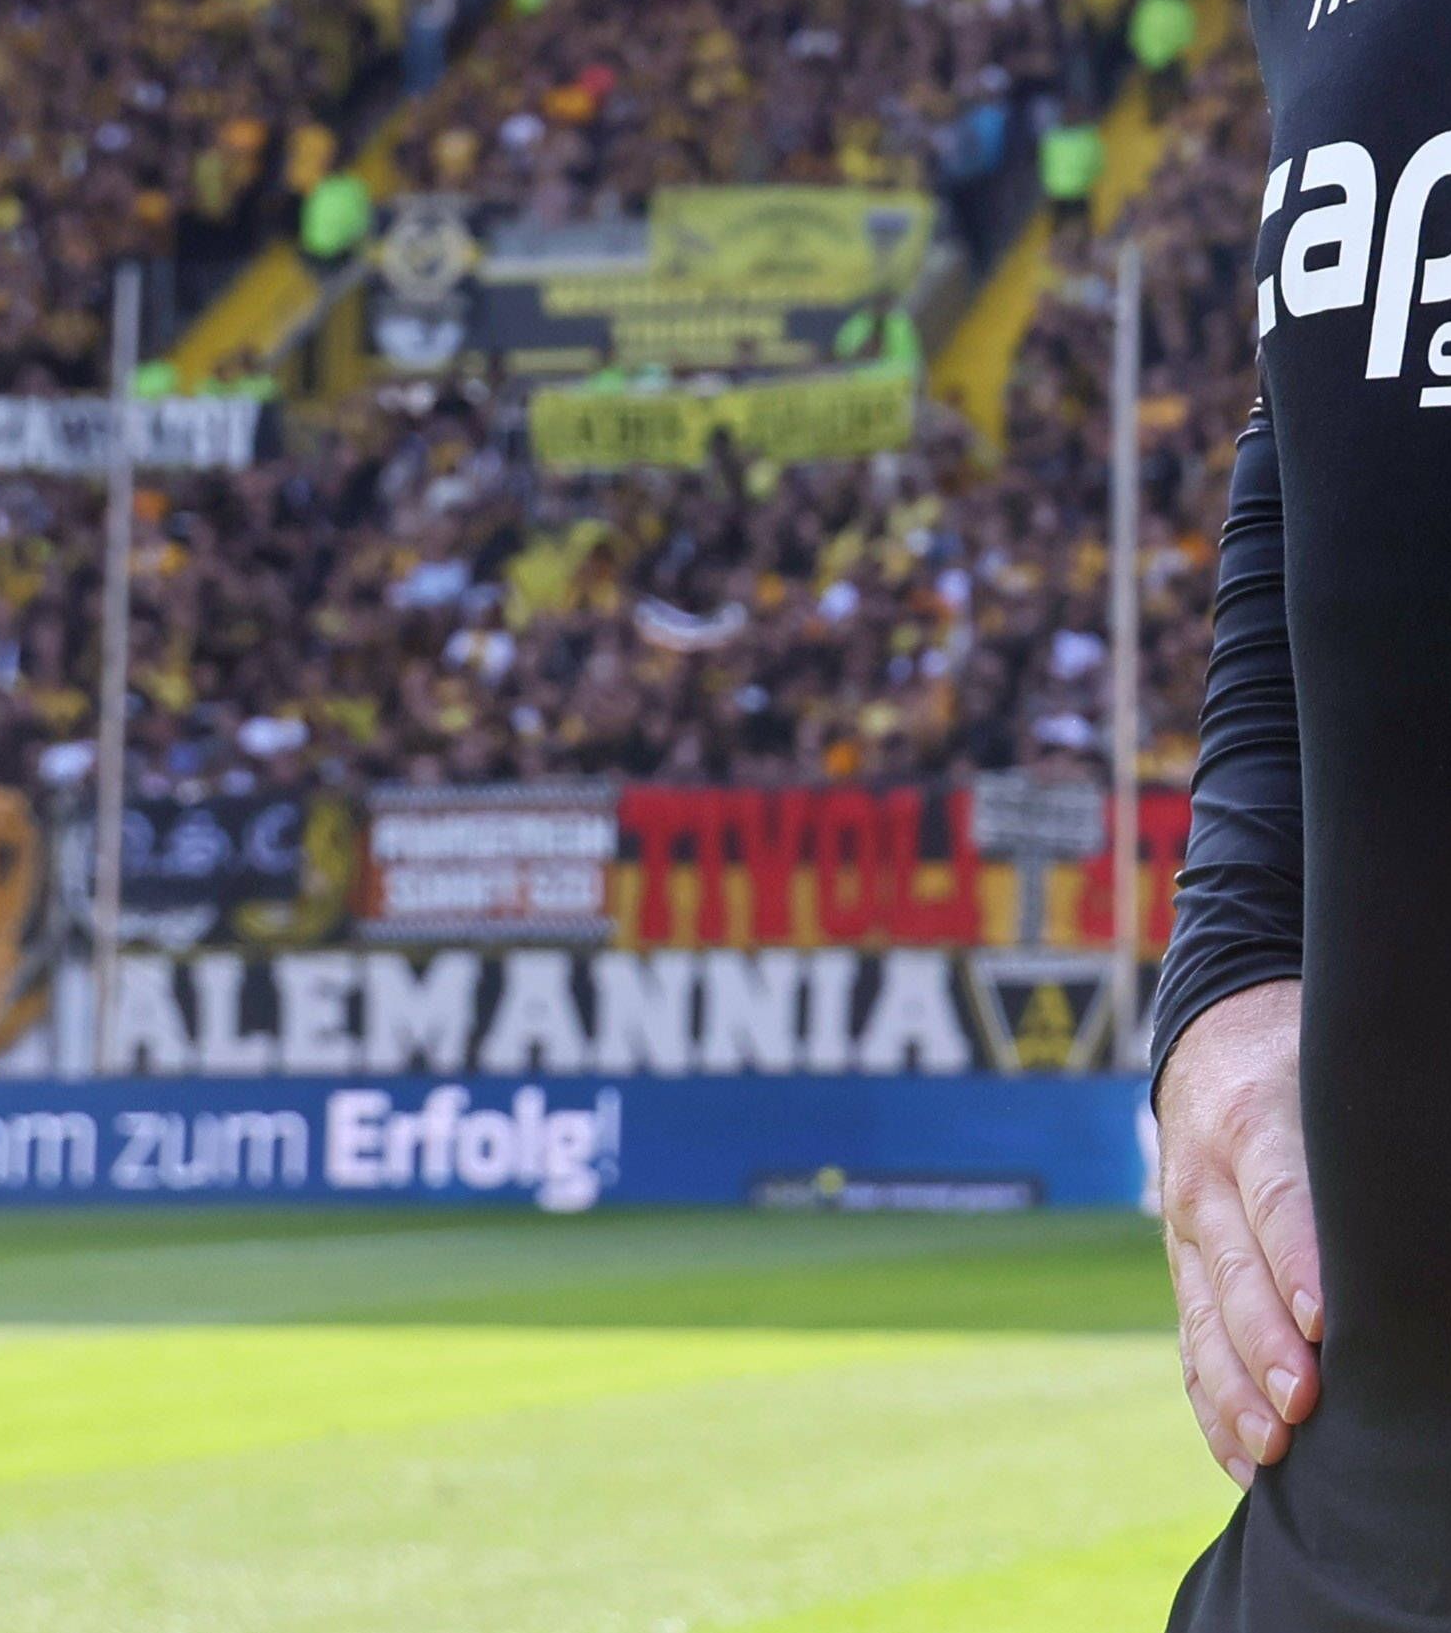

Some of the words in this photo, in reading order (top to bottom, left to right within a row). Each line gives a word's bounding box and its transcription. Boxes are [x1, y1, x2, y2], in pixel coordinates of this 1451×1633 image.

[111, 950, 971, 1075] ALEMANNIA
[111, 1110, 309, 1192] zum
[323, 1084, 623, 1214] Erfolg!
